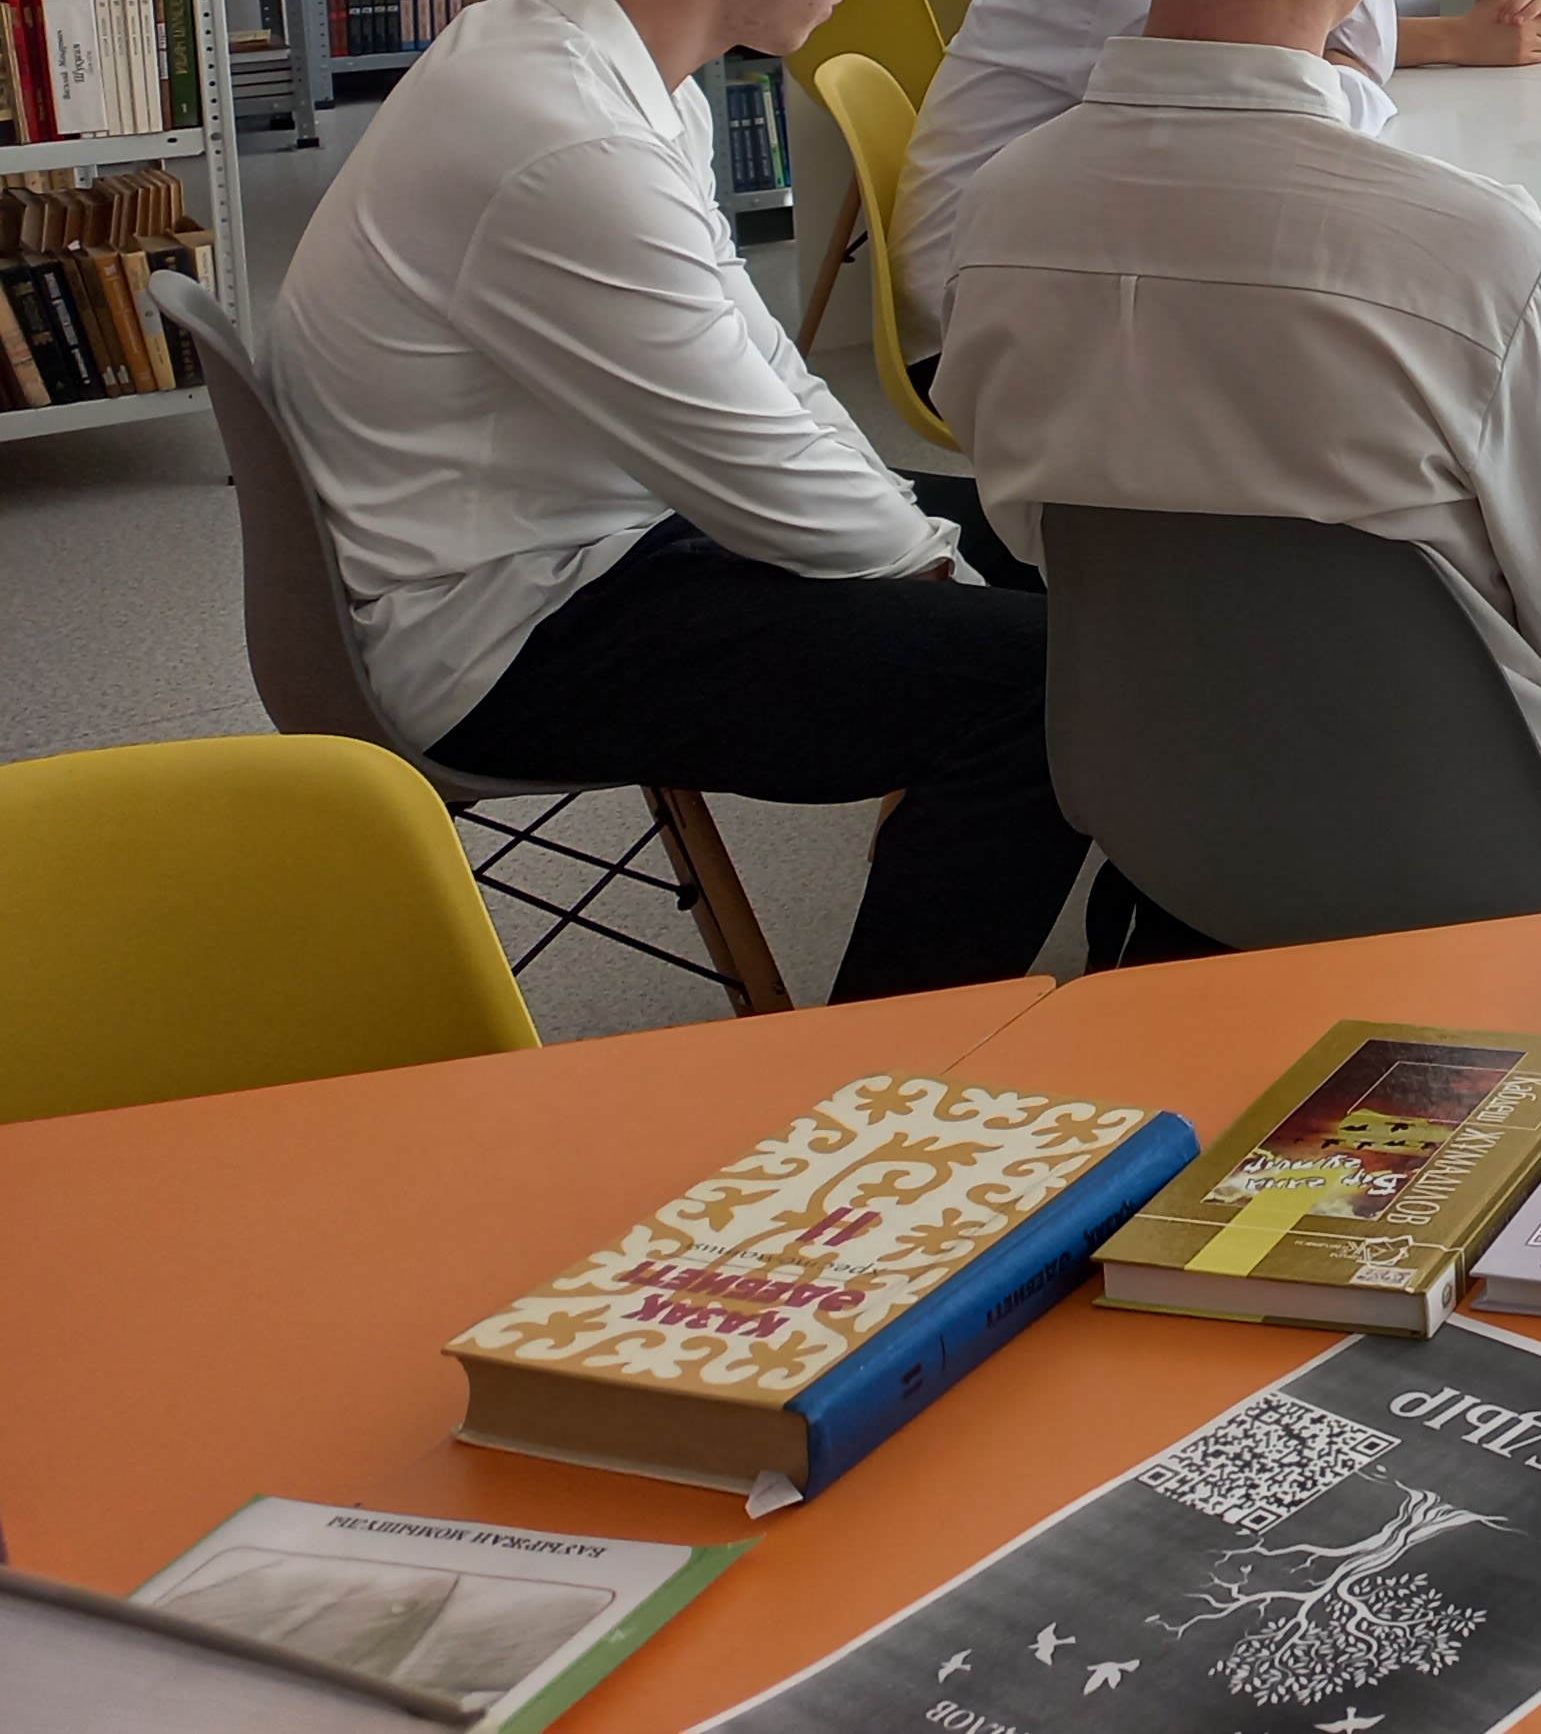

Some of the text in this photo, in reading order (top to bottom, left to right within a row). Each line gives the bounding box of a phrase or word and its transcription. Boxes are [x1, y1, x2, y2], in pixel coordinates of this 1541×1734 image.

[794, 1206, 881, 1247] 11
[617, 1258, 867, 1313] ӘДЕБИЕТІ
[619, 1292, 791, 1339] ҚАЗАҚ
